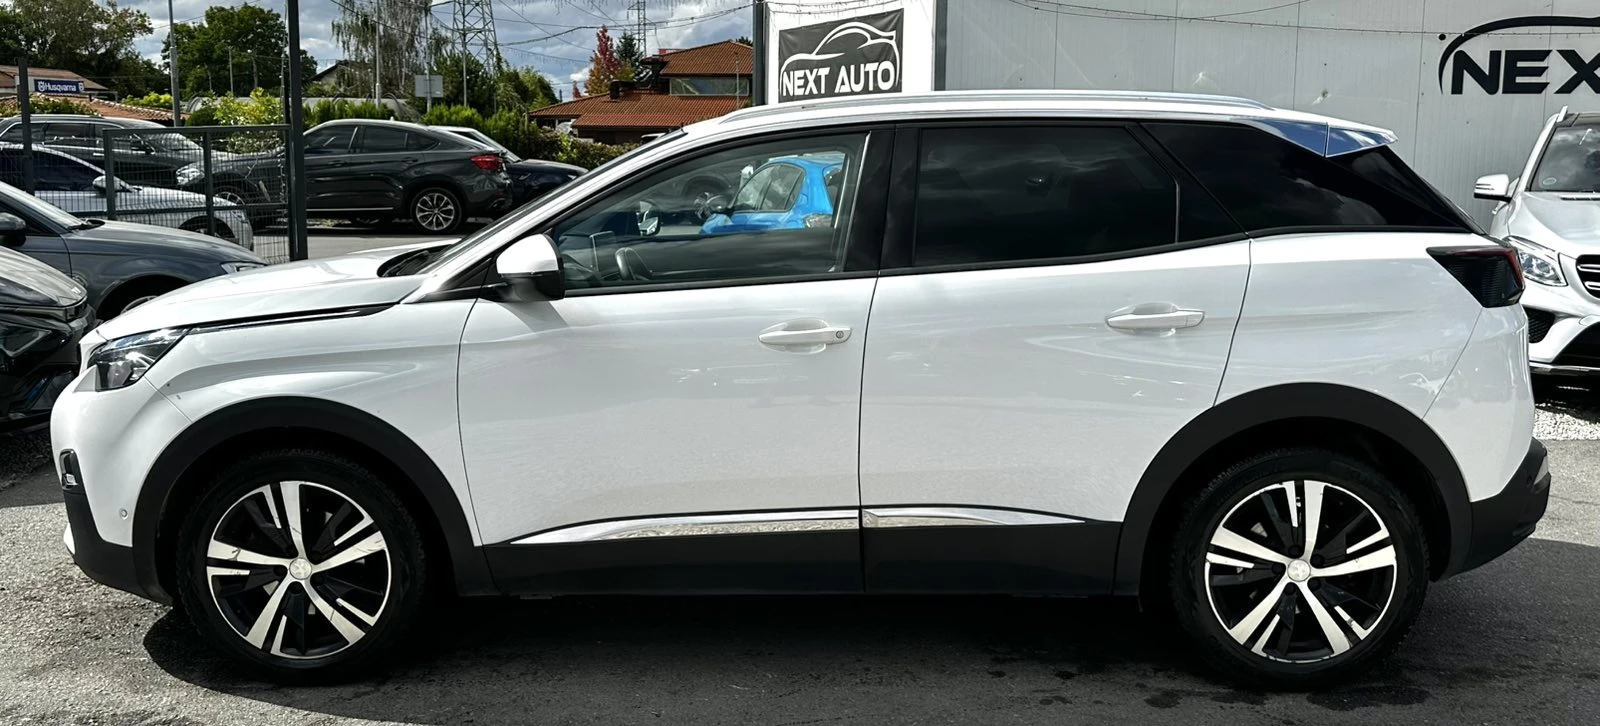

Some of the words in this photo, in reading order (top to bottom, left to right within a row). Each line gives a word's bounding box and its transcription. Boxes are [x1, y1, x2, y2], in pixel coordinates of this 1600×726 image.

[45, 82, 77, 92] Husqvarna
[782, 67, 831, 96] NEXT
[834, 60, 895, 93] AUTO
